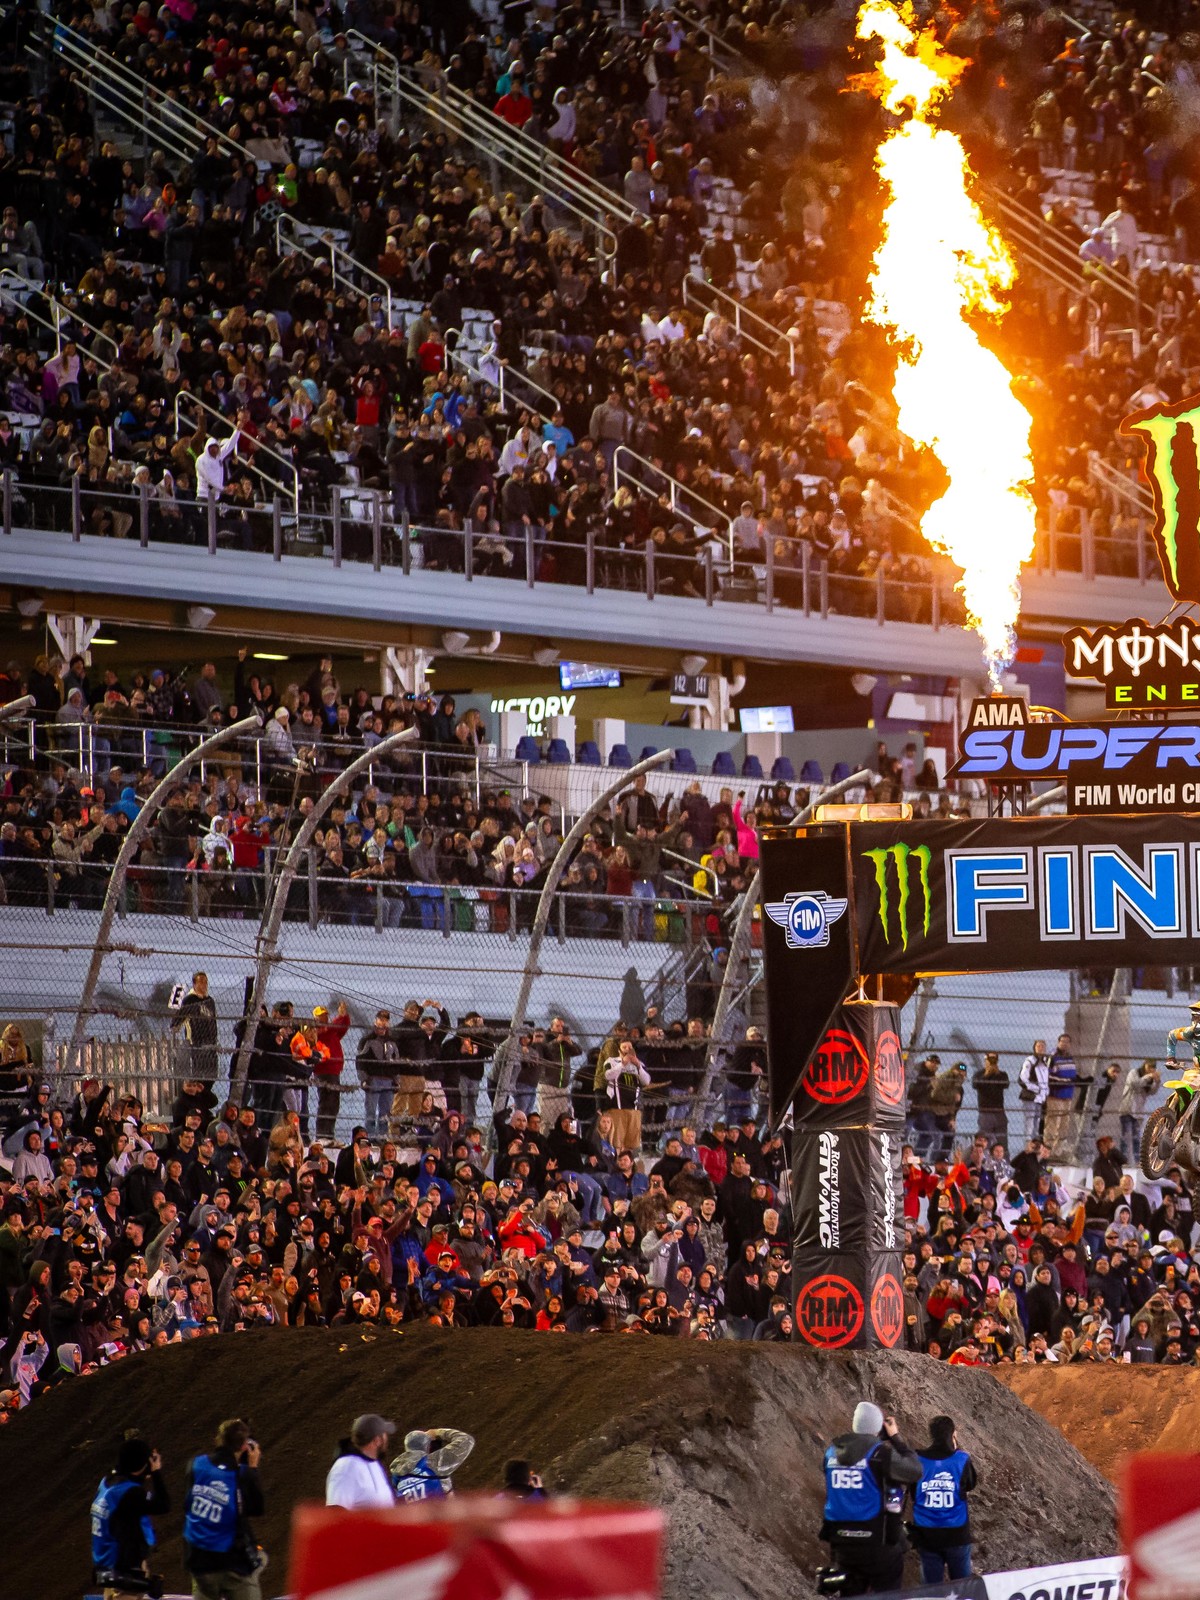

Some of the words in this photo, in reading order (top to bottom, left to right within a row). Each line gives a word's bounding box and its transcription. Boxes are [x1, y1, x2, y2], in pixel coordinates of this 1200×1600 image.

[973, 704, 1024, 727] AMA
[1074, 785, 1111, 806] FIM
[1117, 783, 1175, 804] World
[793, 908, 820, 931] FIM
[831, 1149, 841, 1187] ROCKY
[831, 1187, 841, 1249] MOUNTAIN
[831, 1469, 864, 1489] 052
[190, 1496, 223, 1523] 070
[924, 1491, 955, 1508] 090
